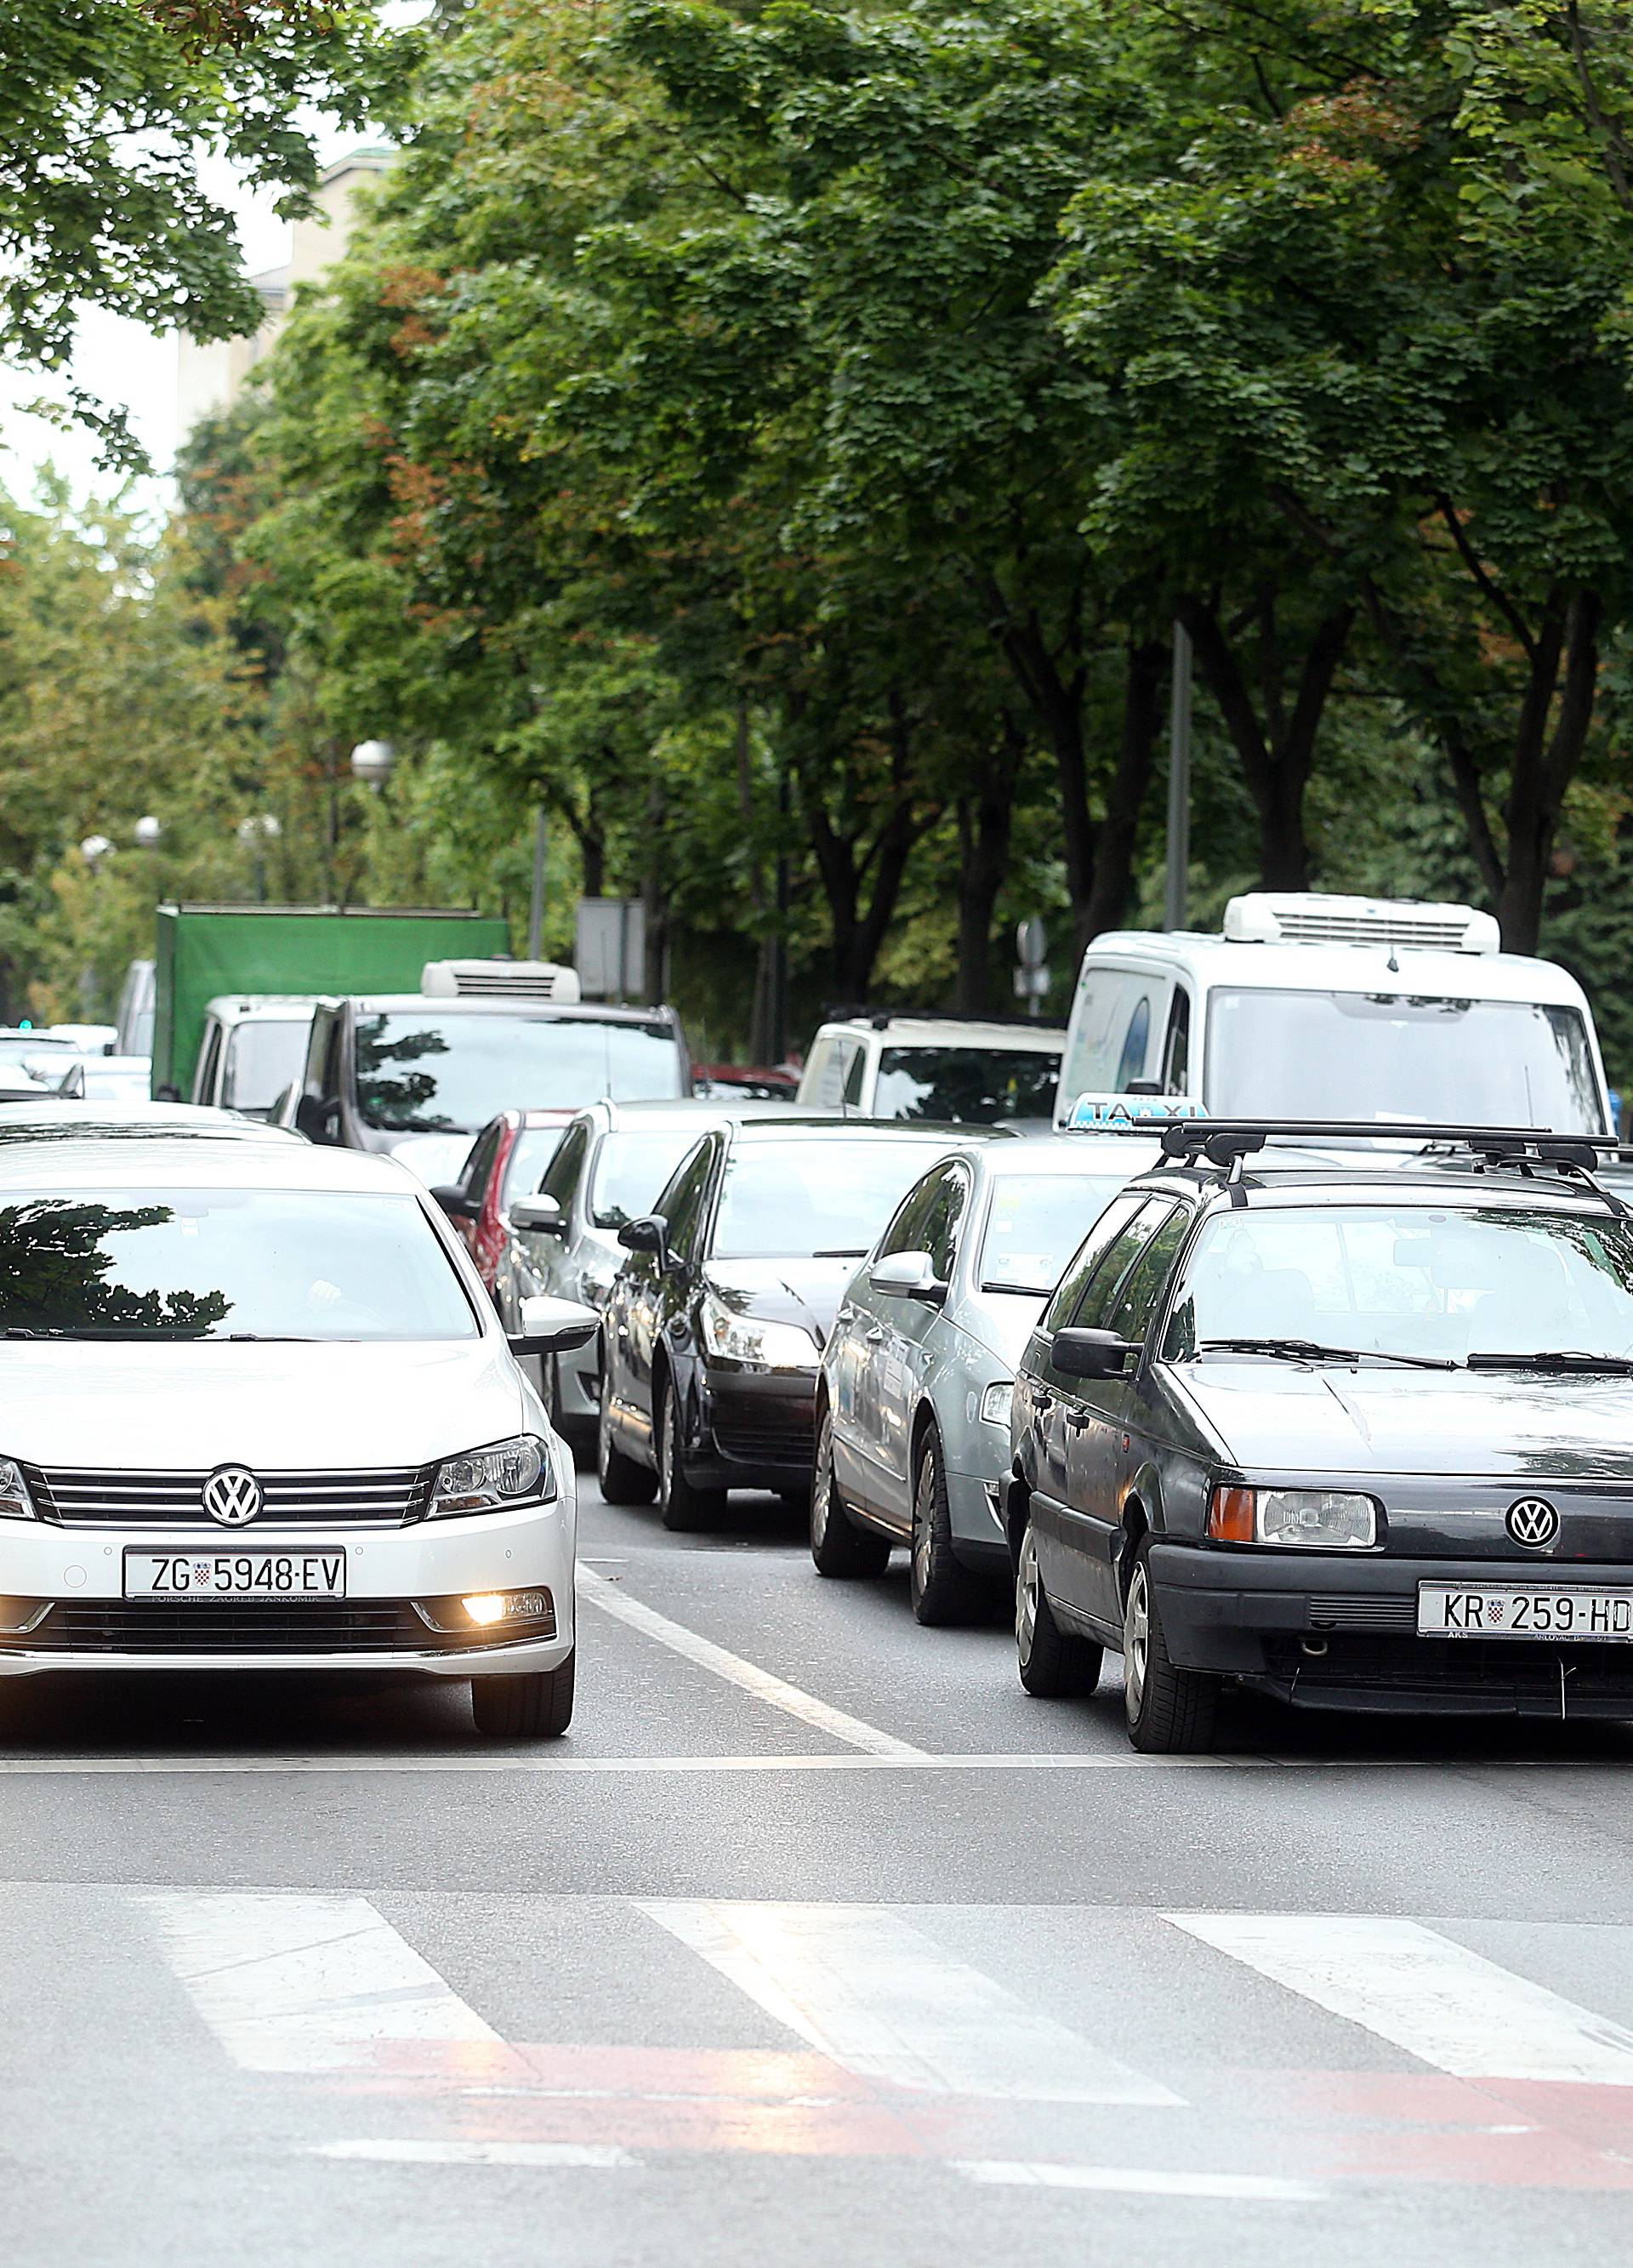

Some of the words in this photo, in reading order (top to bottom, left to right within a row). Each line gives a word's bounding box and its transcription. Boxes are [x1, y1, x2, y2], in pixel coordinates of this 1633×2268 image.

[151, 1559, 191, 1591] ZG
[1444, 1594, 1483, 1628] KR
[1511, 1596, 1630, 1632] 259-HD
